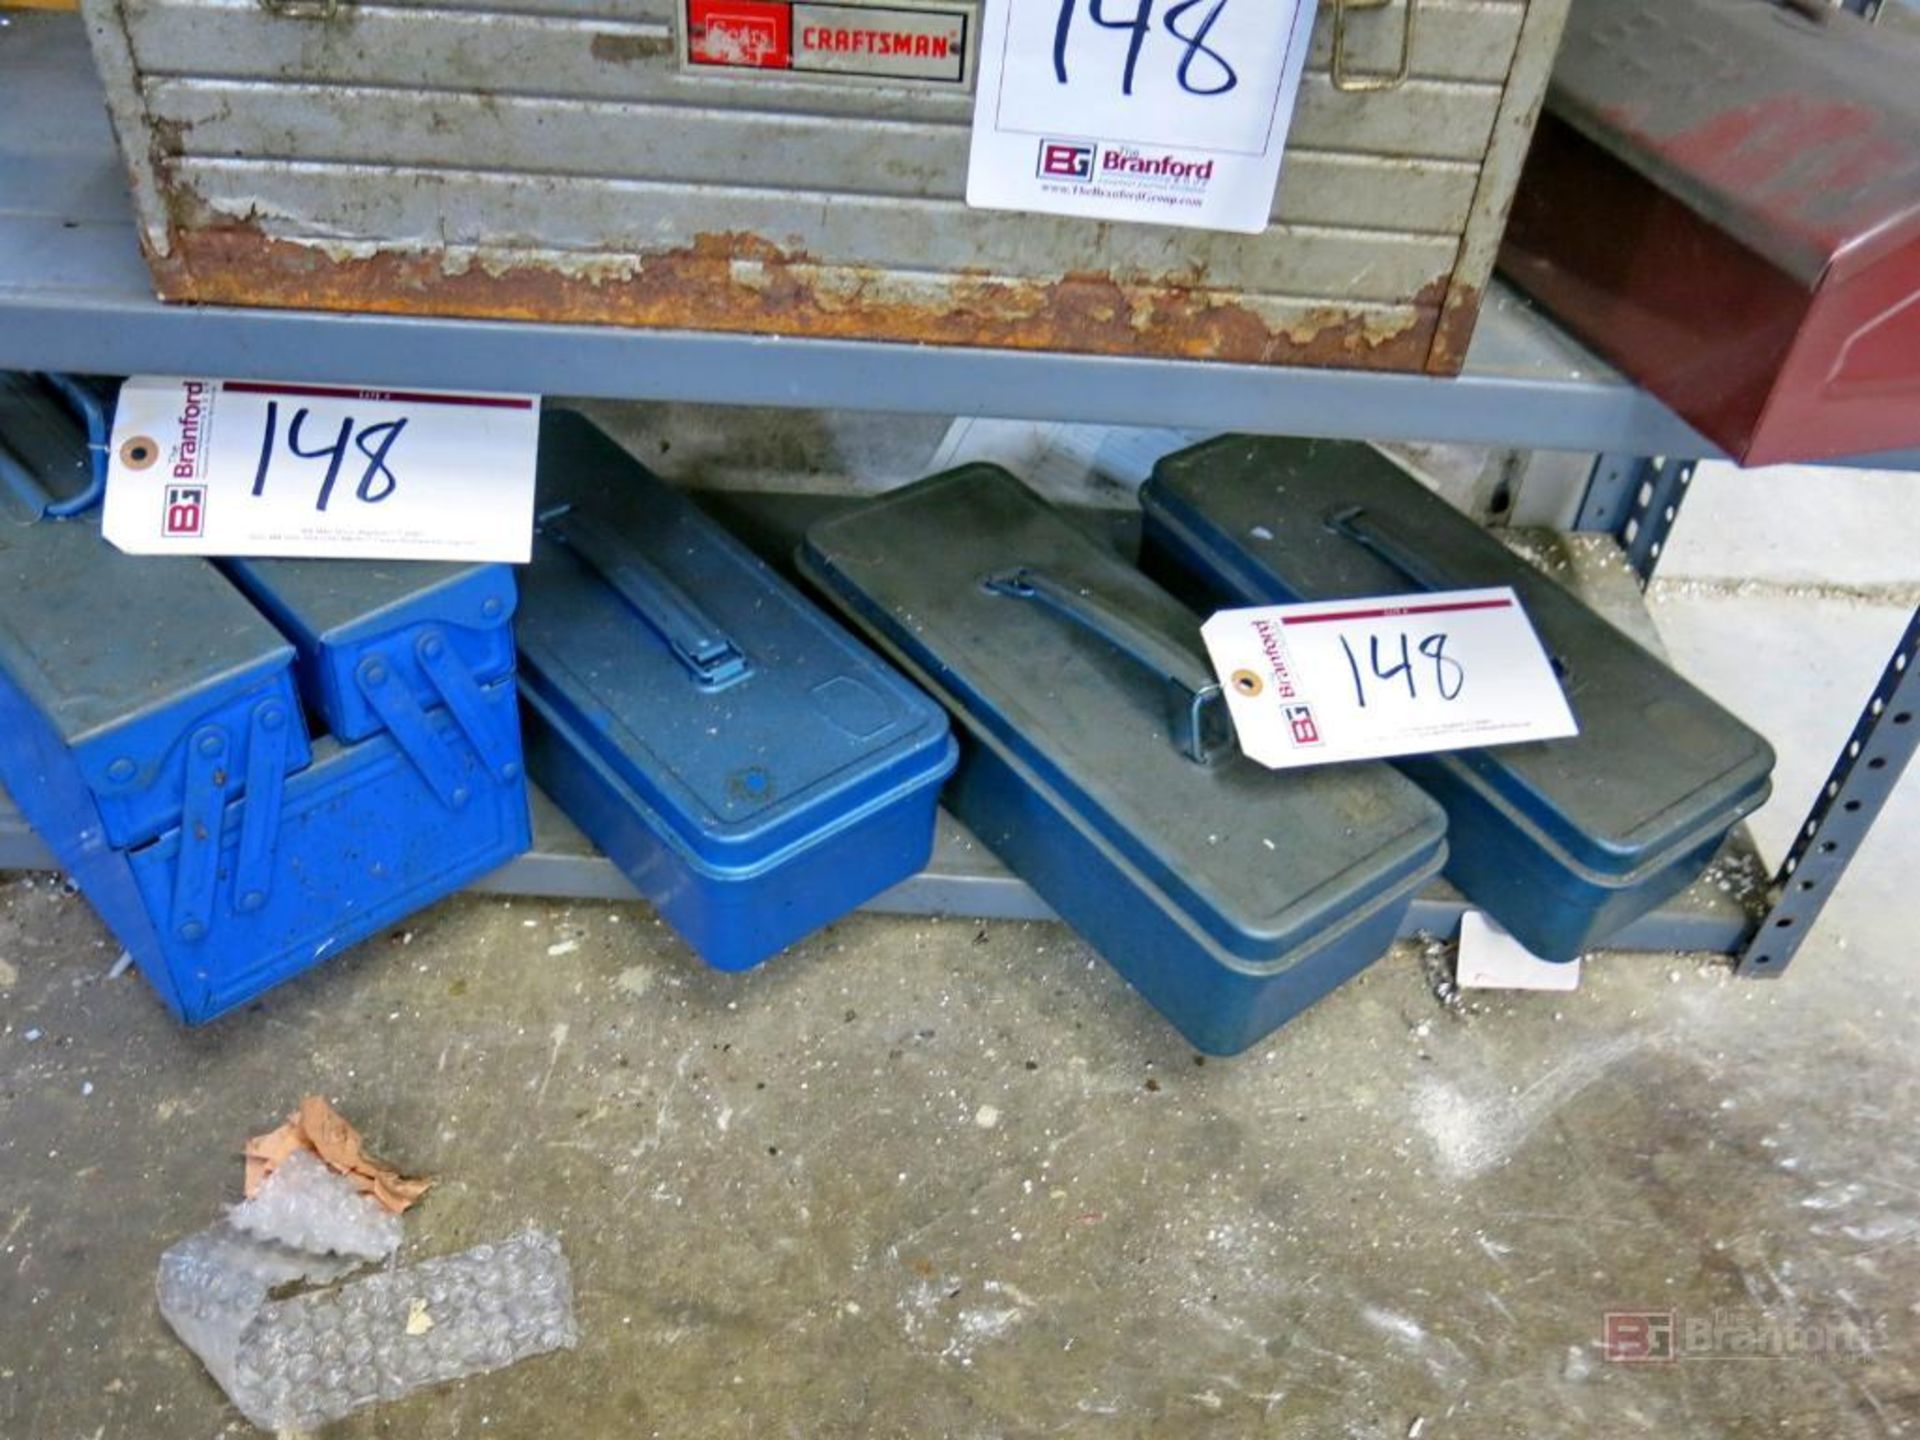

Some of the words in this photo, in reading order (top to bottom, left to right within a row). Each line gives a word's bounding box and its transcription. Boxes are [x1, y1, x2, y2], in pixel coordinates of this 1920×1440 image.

[803, 26, 948, 59] CRAFTSMAN
[1053, 0, 1238, 96] 148
[1043, 144, 1092, 177] BG
[1102, 149, 1214, 181] Branford
[172, 381, 204, 479] Branford
[251, 400, 409, 512] 148
[168, 489, 202, 533] BG
[1340, 632, 1464, 708] 148
